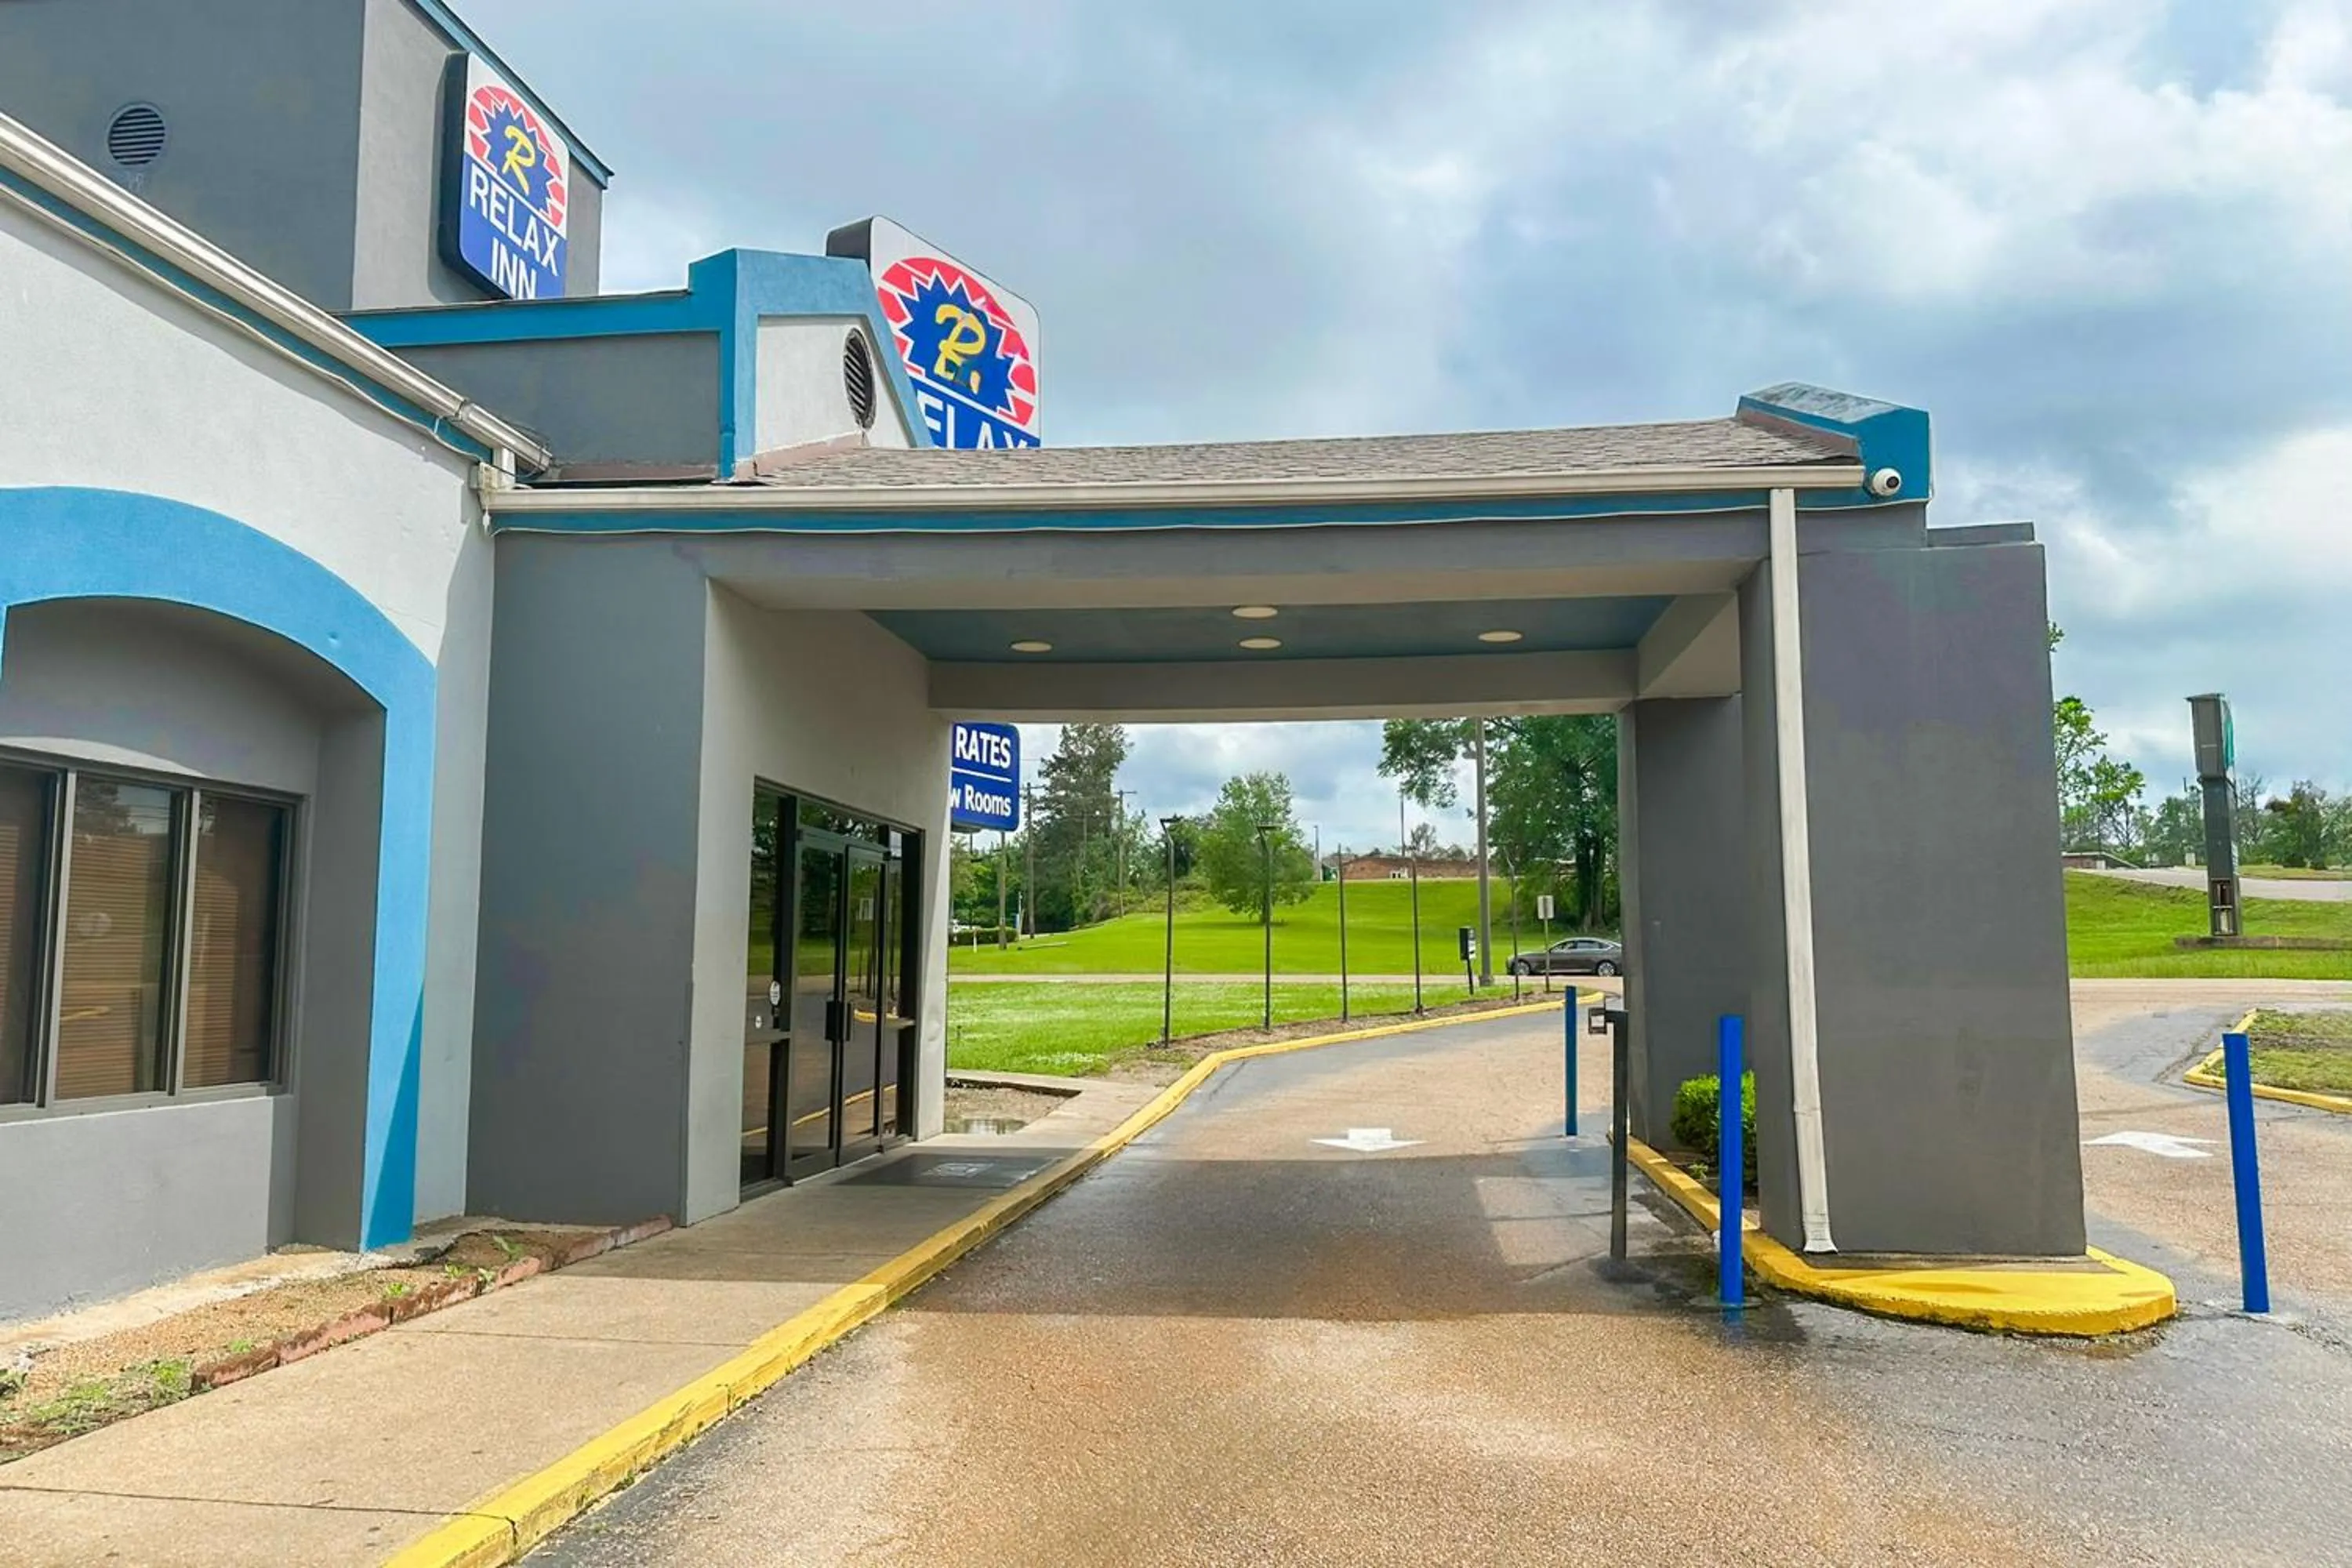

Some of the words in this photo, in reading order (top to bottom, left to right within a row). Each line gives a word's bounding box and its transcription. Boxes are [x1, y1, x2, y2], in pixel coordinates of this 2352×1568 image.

[470, 163, 559, 276] RELAX
[491, 237, 536, 299] INN
[955, 725, 1011, 769] RATES
[965, 784, 1012, 817] Rooms
